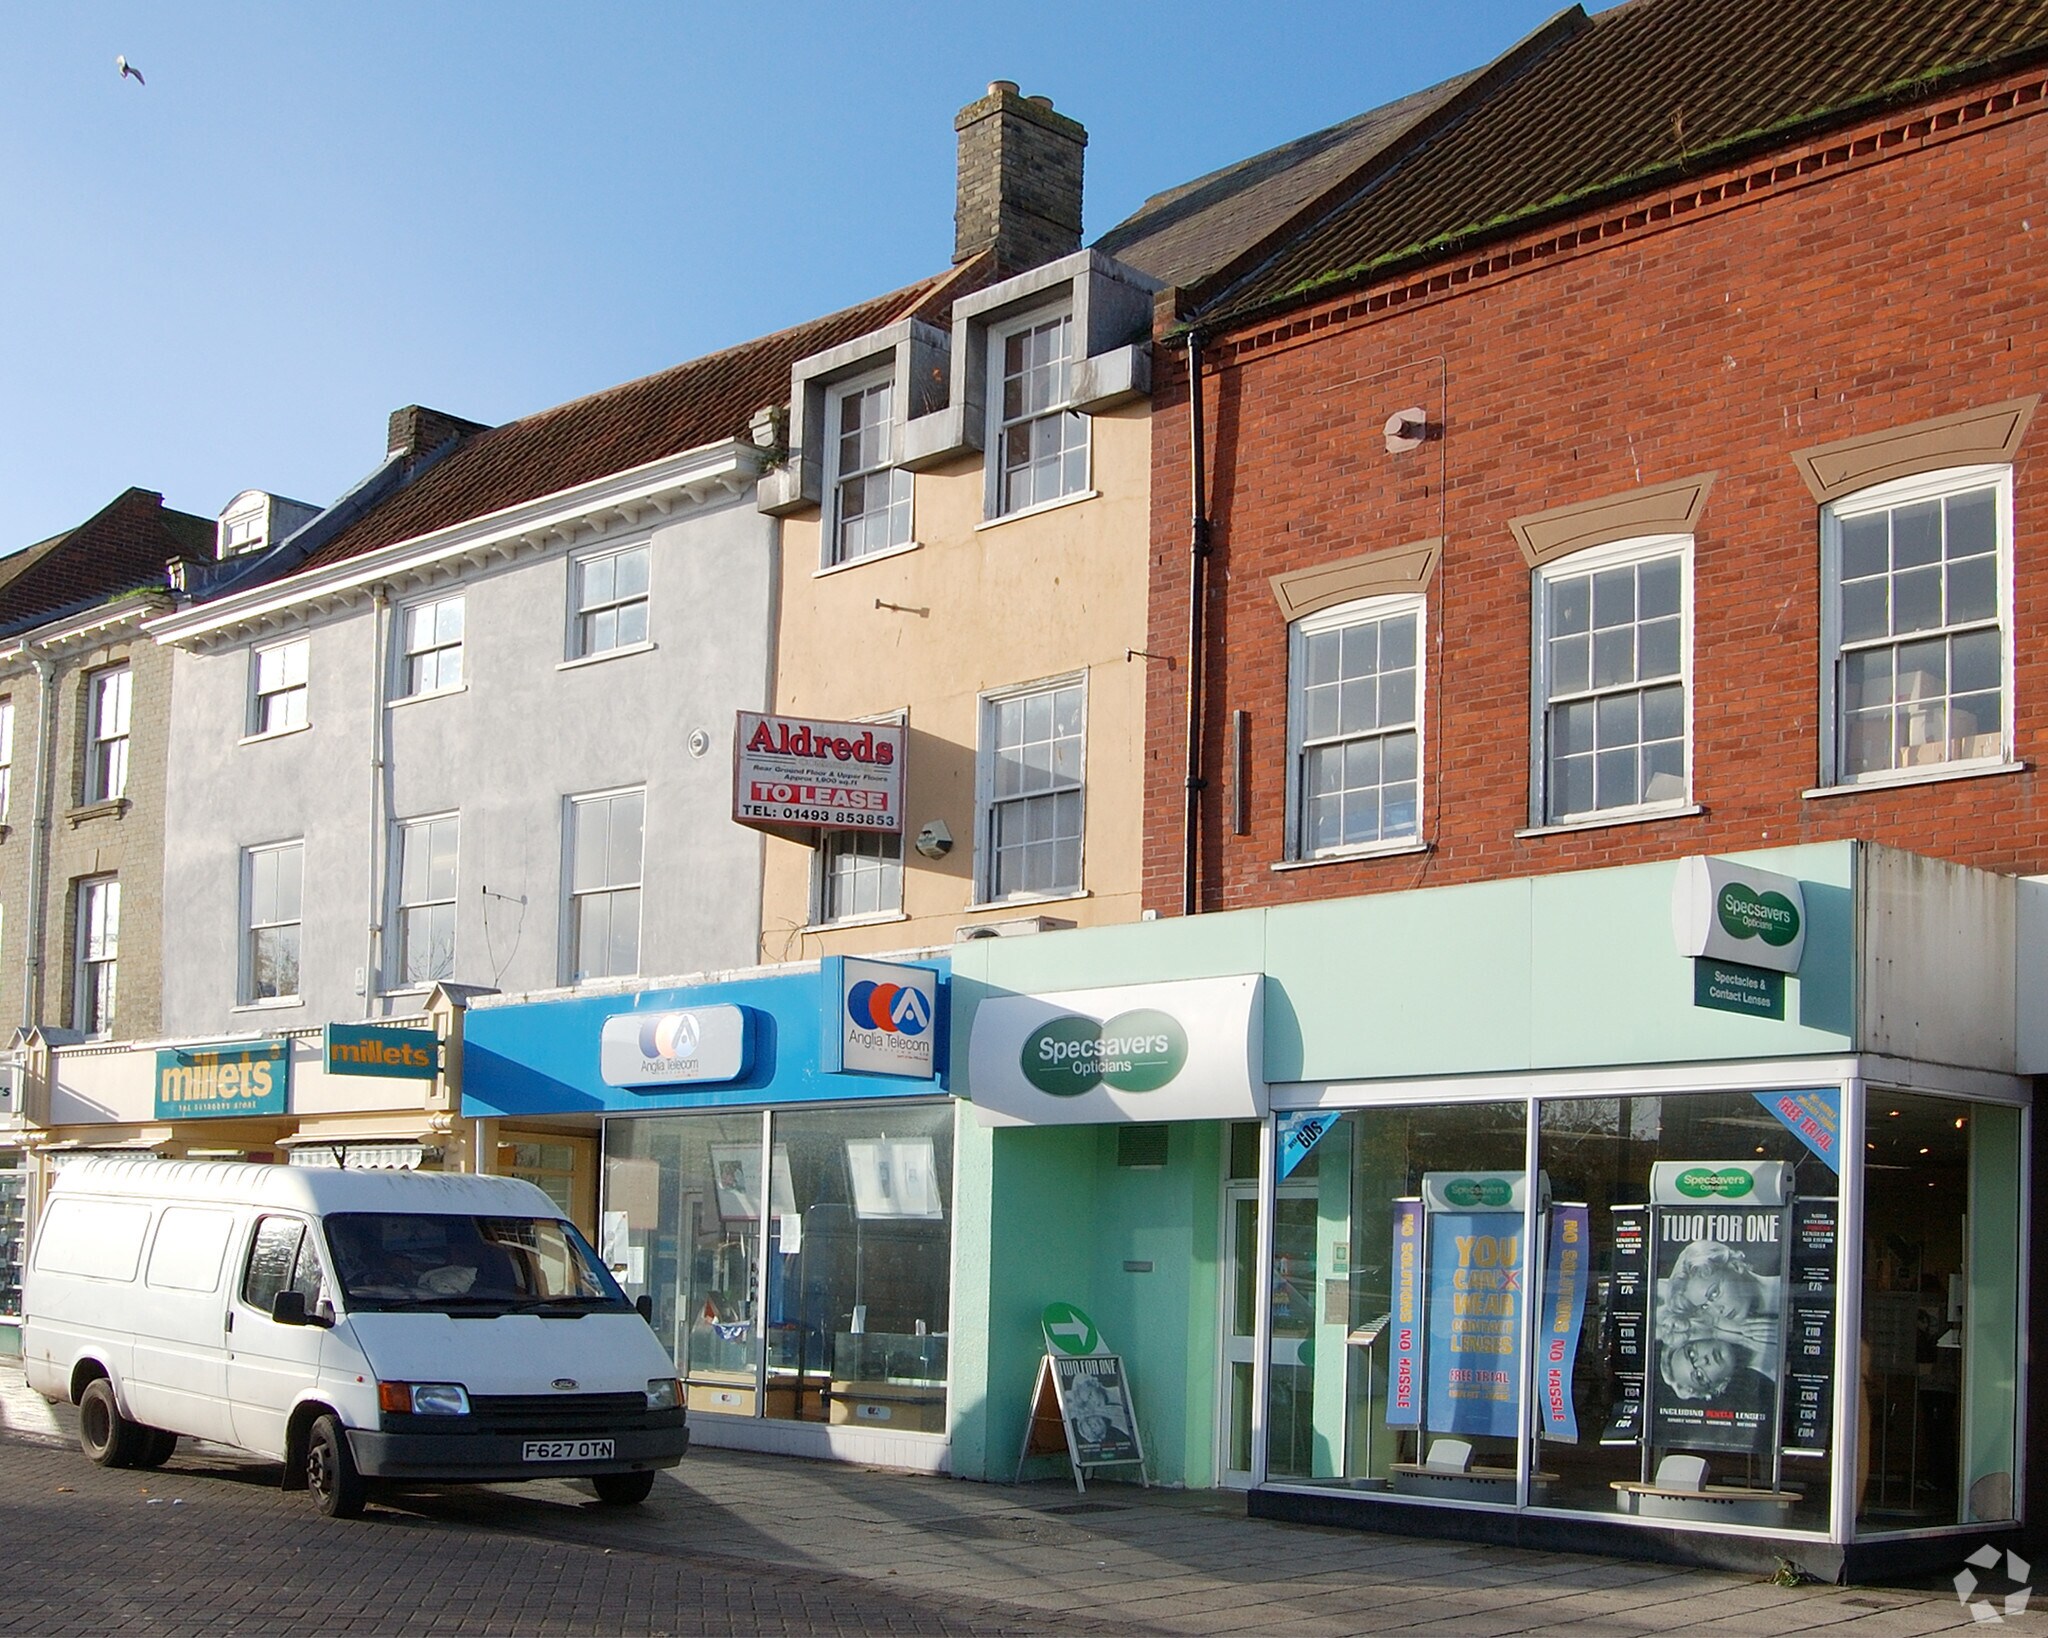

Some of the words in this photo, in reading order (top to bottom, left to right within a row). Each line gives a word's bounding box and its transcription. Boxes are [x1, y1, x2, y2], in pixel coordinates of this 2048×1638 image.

[747, 720, 893, 765] Aldreds
[775, 766, 805, 774] Ground
[837, 772, 861, 780] Upper
[863, 774, 888, 782] Floors
[784, 774, 812, 783] Approx
[756, 783, 792, 802] TO
[801, 786, 883, 810] LEASE
[743, 804, 777, 817] TEL:
[783, 808, 829, 822] 01493
[836, 812, 895, 826] 853853
[1725, 893, 1791, 923] Specsavers
[1742, 915, 1773, 931] Opticians
[1714, 970, 1759, 989] Spectacles
[1760, 979, 1766, 990] &
[1709, 986, 1741, 1002] Contact
[1743, 992, 1771, 1007] Lenses
[849, 1029, 883, 1049] Anglia
[886, 1033, 929, 1052] Telecom
[1039, 1034, 1168, 1064] Specsavers
[331, 1040, 429, 1067] millets
[161, 1051, 273, 1103] millets
[641, 1060, 665, 1074] Anglia
[667, 1058, 699, 1070] Telecom
[1072, 1059, 1132, 1076] Opticians
[1777, 1095, 1804, 1122] FREE
[1800, 1116, 1833, 1152] TRIAL
[1684, 1175, 1745, 1187] Specsavers
[1402, 1213, 1414, 1237] NO
[1563, 1219, 1579, 1243] NO
[1662, 1214, 1703, 1242] TWO
[1707, 1214, 1743, 1242] FOR
[1746, 1214, 1779, 1242] ONE
[1456, 1235, 1518, 1267] YOU
[1400, 1242, 1414, 1323] SOLUTIONS
[1554, 1250, 1578, 1333] SOLUTIONS
[1453, 1292, 1514, 1316] WEAR
[1399, 1329, 1412, 1351] NO
[1450, 1334, 1513, 1355] LENSES
[1548, 1339, 1566, 1361] NO
[1060, 1361, 1080, 1376] TWO
[1081, 1360, 1099, 1375] FOR
[1099, 1359, 1117, 1374] ONE
[1449, 1368, 1472, 1382] FREE
[1475, 1369, 1509, 1384] TRIAL
[1398, 1357, 1412, 1409] HASSLE
[1548, 1369, 1566, 1422] HASSLE
[525, 1443, 574, 1458] F627
[579, 1441, 612, 1457] OTN
